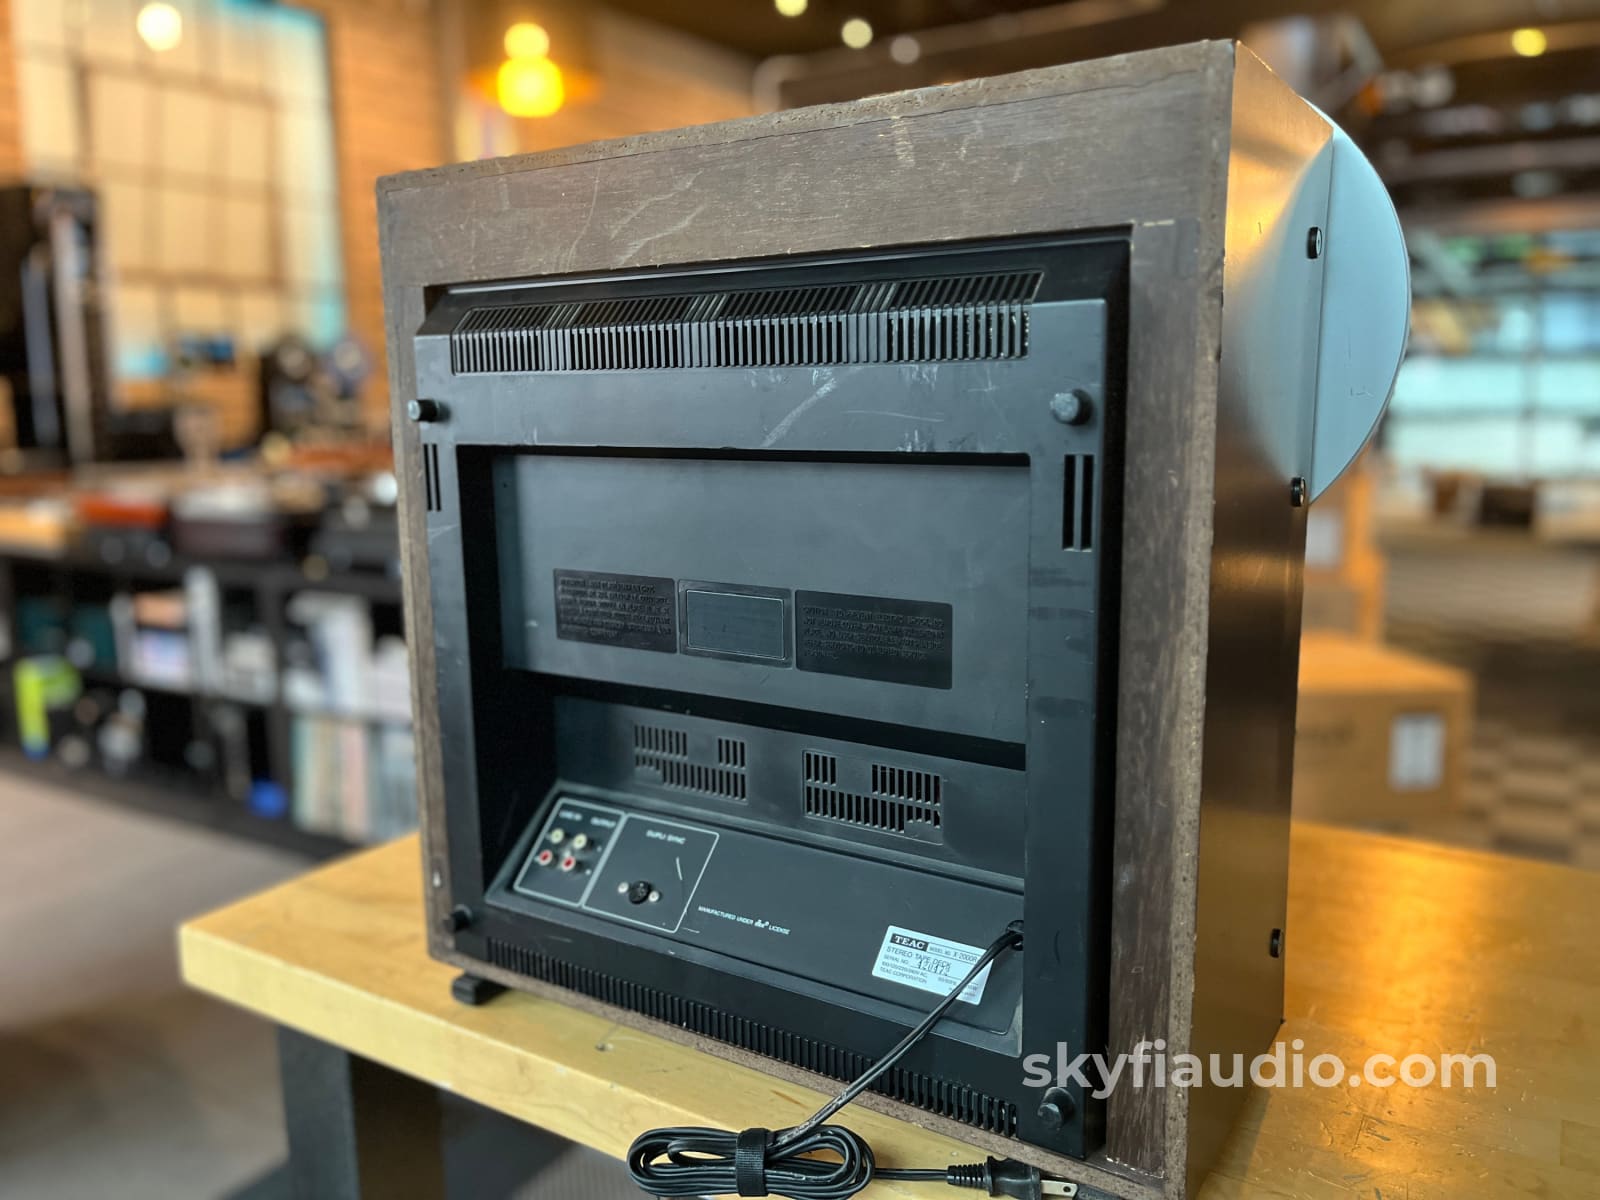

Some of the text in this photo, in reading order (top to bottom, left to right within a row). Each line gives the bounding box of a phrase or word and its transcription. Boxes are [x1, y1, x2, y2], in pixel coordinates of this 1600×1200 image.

[894, 935, 925, 950] TEAC
[886, 946, 952, 967] STEREO TAPE DECK
